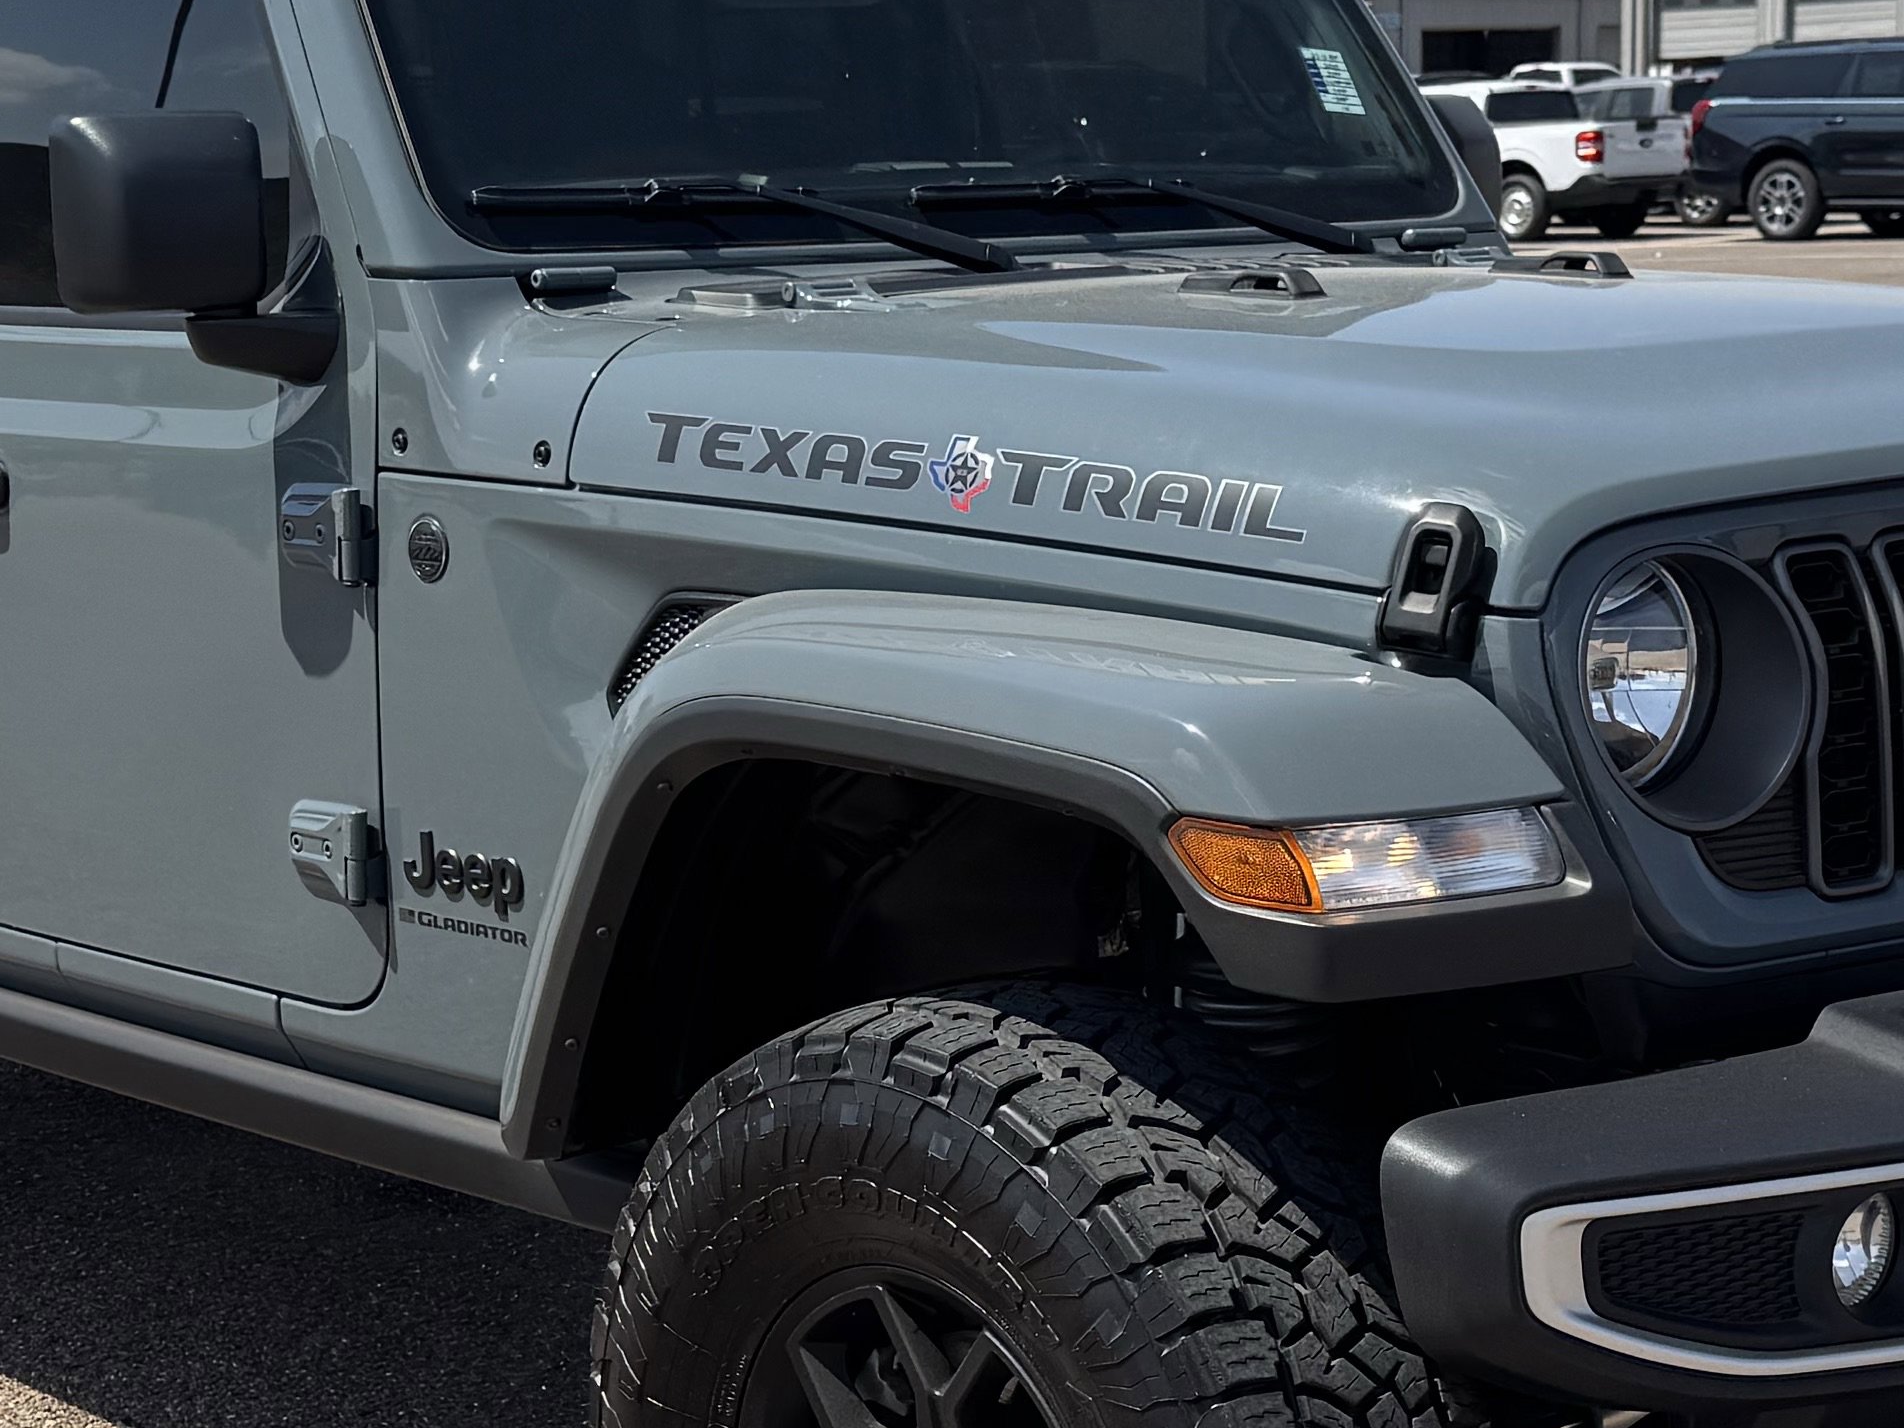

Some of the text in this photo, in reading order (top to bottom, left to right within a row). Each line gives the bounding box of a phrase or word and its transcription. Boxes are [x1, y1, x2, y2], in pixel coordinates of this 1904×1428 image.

[645, 410, 1307, 543] TEXAS TRAIL
[403, 830, 525, 922] Jeep
[417, 911, 529, 948] GLADIATOR
